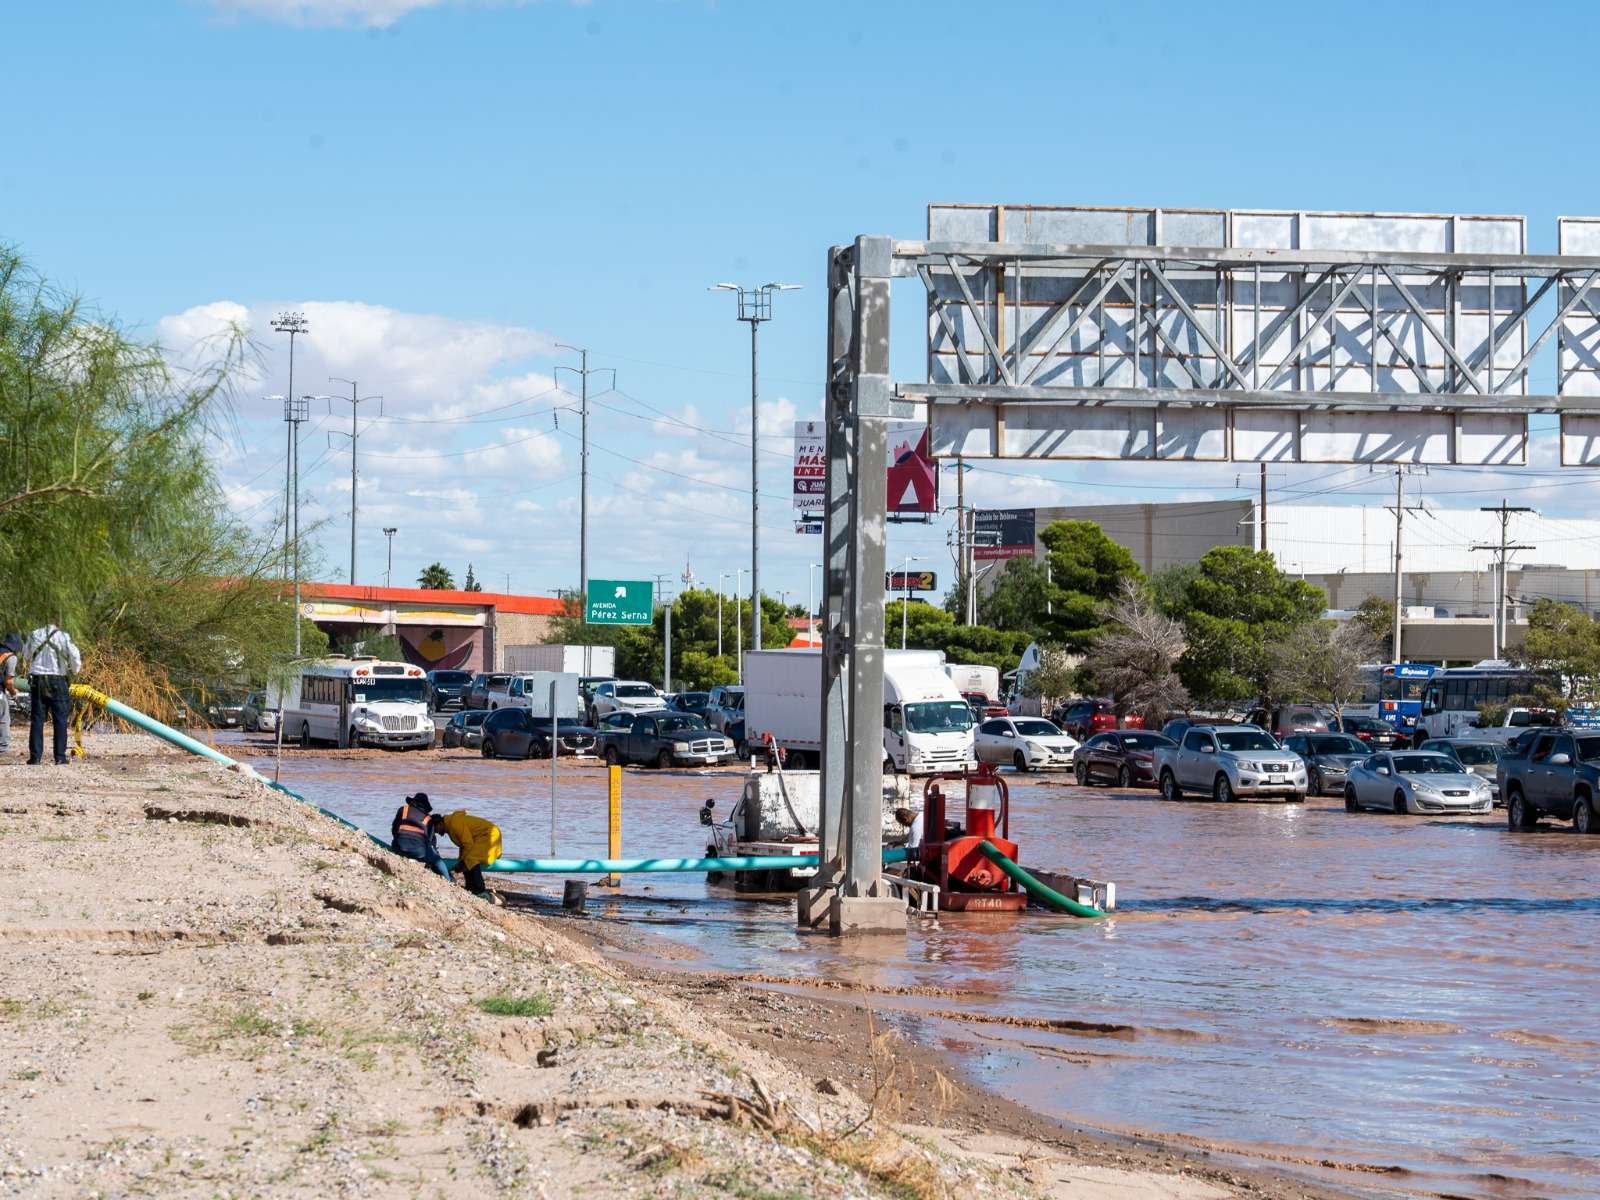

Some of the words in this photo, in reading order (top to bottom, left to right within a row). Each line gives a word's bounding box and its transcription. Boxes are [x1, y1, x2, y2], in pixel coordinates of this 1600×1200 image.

[798, 453, 828, 465] MÁS
[592, 610, 616, 618] Pérez
[622, 610, 648, 620] Serna
